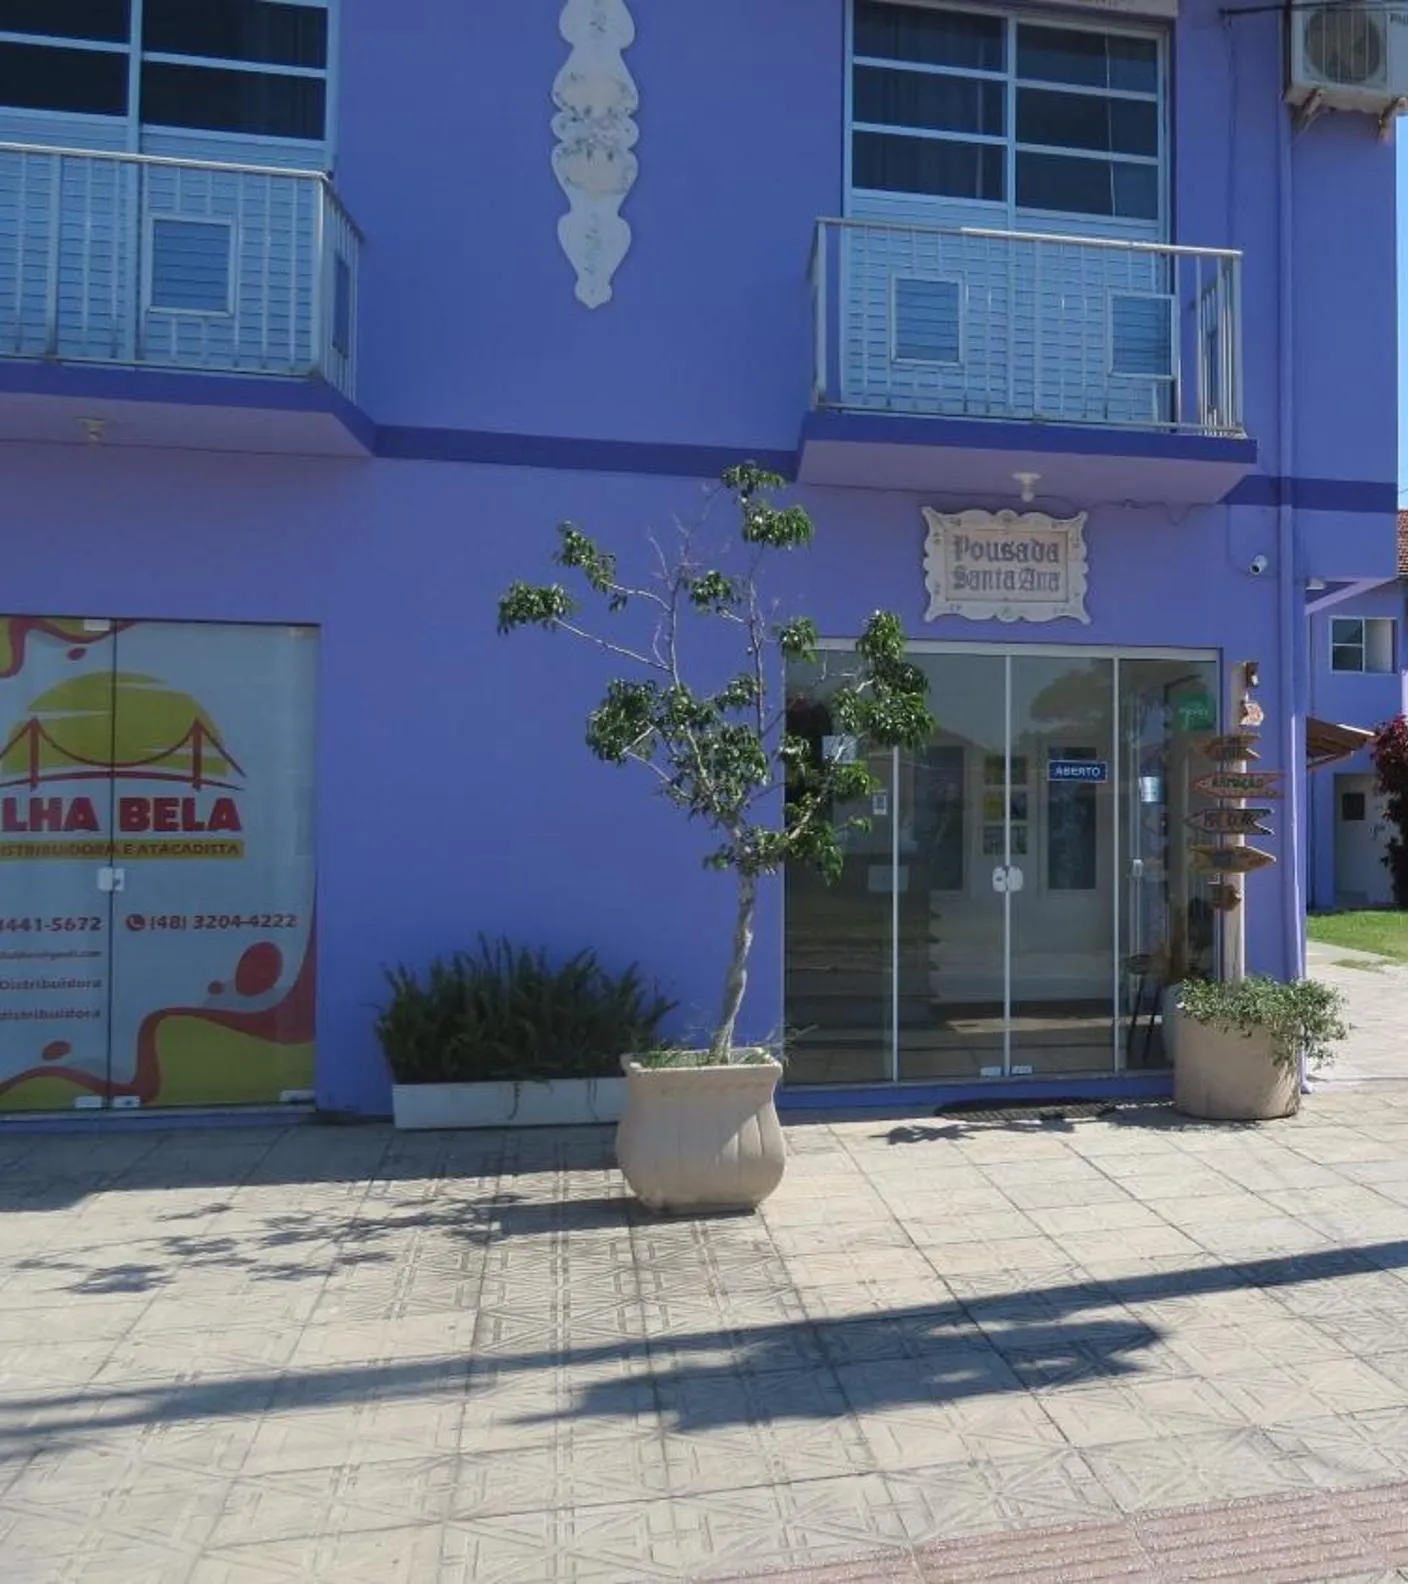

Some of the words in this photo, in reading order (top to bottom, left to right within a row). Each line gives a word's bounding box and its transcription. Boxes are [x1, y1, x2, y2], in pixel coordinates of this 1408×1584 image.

[952, 534, 1060, 563] Pousada
[952, 565, 1015, 591] Santa
[1018, 567, 1061, 592] Ana
[1054, 765, 1101, 776] ABERTO
[2, 797, 101, 832] LHA
[119, 797, 242, 832] BELA
[136, 843, 241, 855] ATACADISTA
[150, 915, 187, 931] (48)
[193, 914, 298, 930] 3204-4222
